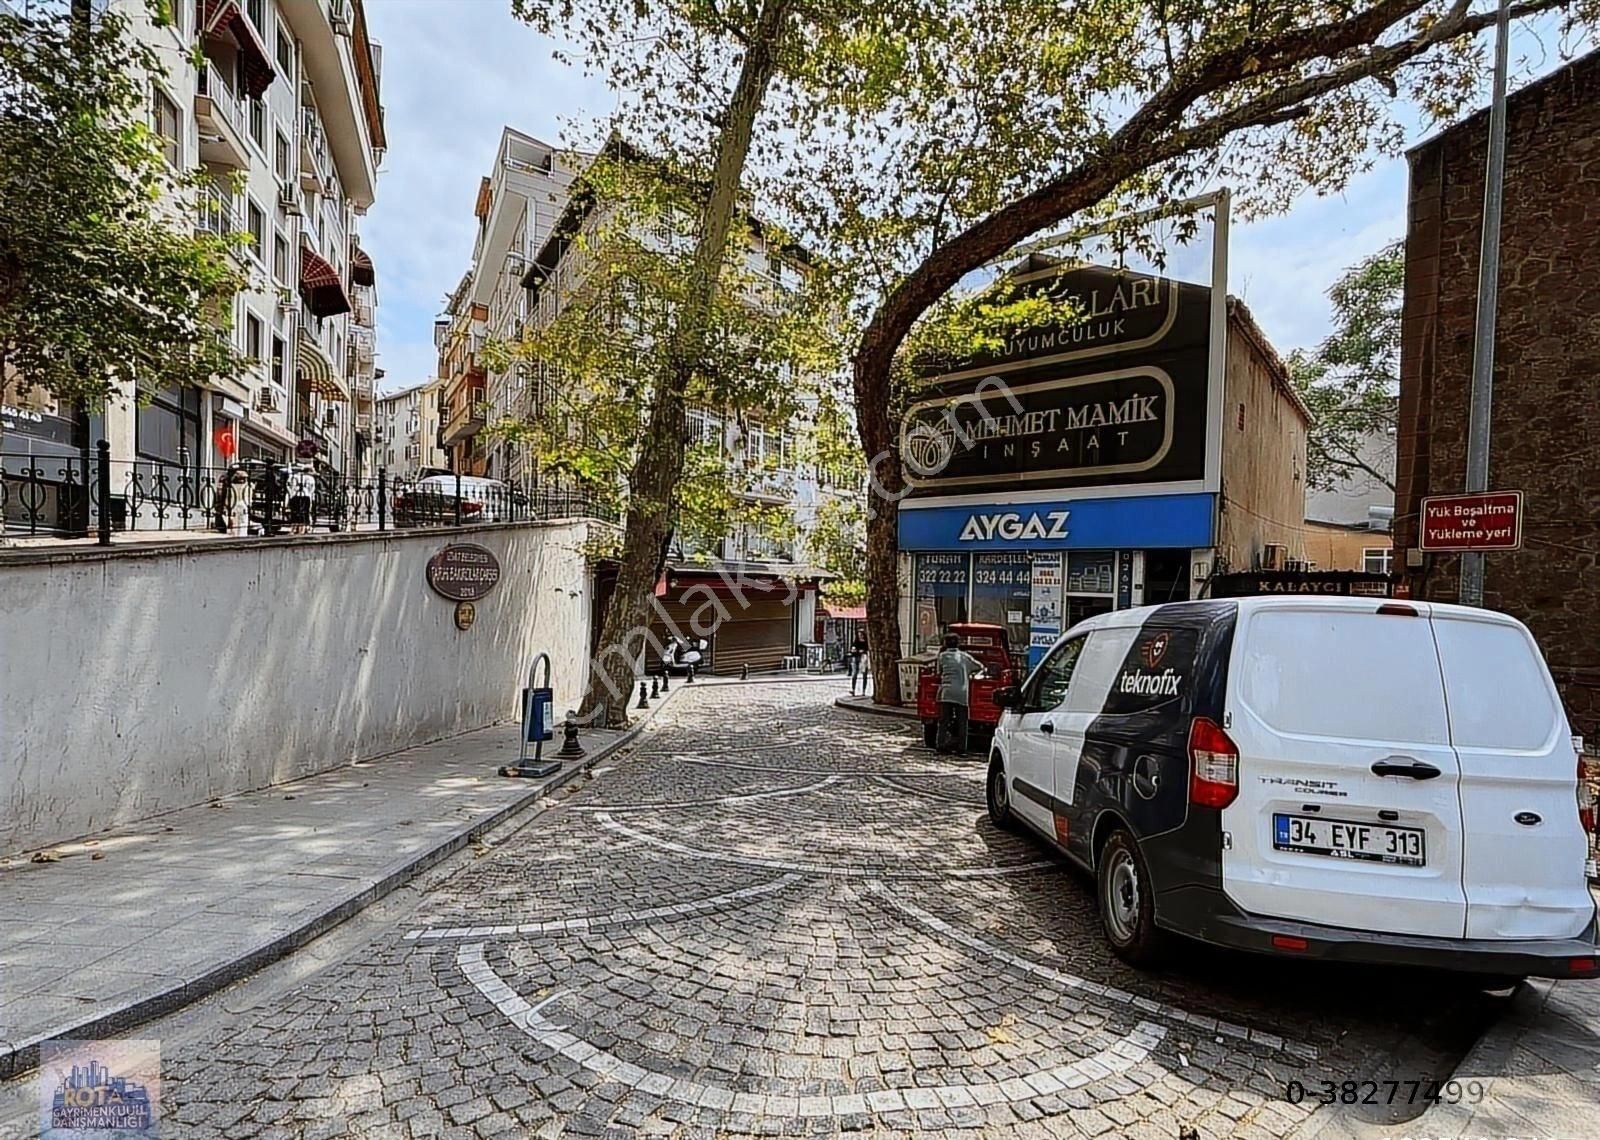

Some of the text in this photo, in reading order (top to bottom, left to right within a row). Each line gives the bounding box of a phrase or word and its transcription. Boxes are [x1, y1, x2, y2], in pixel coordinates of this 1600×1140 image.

[964, 393, 1159, 441] MEHMET MAMİK
[1428, 503, 1514, 518] Yük Boşaltma
[959, 511, 1070, 540] AYGAZ
[1428, 526, 1511, 540] Yükleme yeri
[919, 570, 966, 583] 322 22 22
[976, 570, 997, 584] 324
[999, 570, 1013, 584] 44
[1016, 570, 1030, 584] 44
[1258, 581, 1342, 593] KALAYCI
[1120, 668, 1182, 696] teknofix
[1258, 776, 1338, 790] TRANSIT
[1291, 820, 1420, 856] 34 EYF 313
